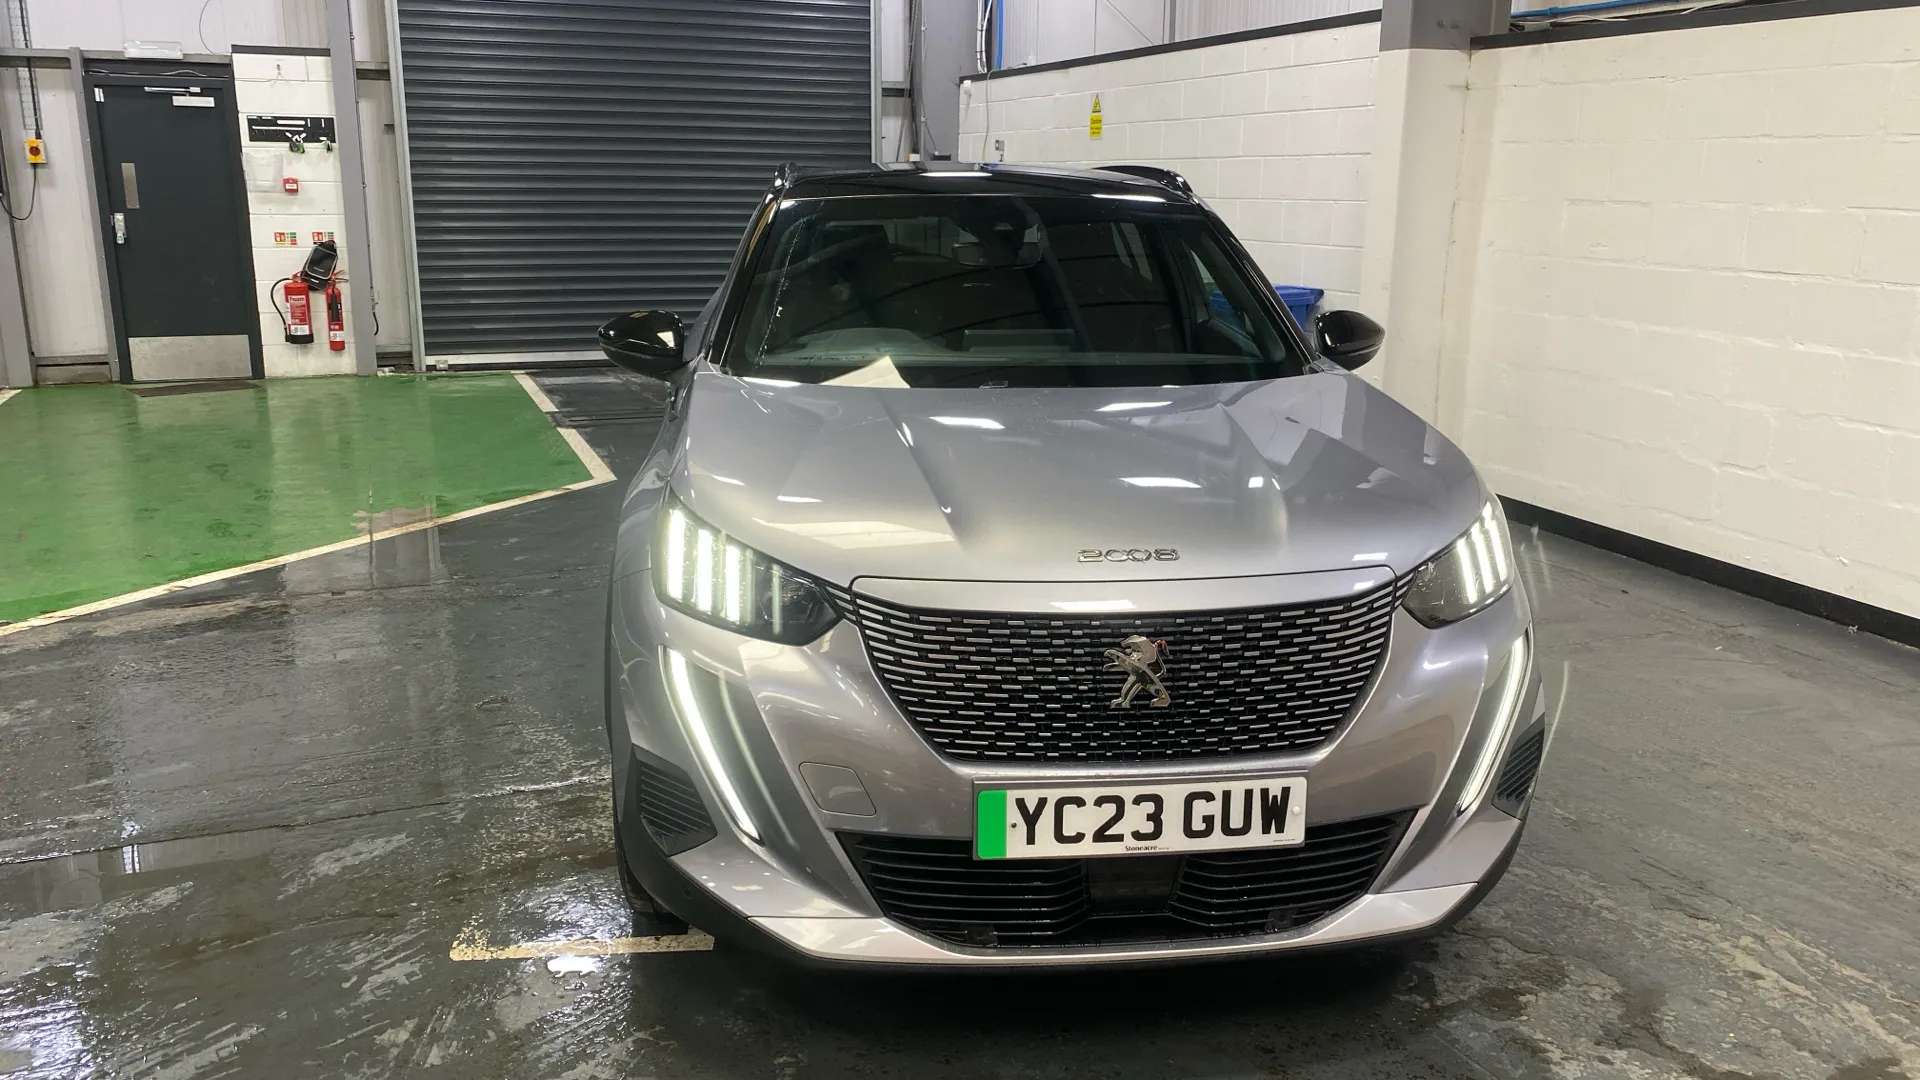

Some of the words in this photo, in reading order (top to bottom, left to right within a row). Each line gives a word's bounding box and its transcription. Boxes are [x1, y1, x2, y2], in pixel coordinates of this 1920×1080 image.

[1078, 548, 1180, 562] 2008
[1015, 793, 1164, 845] YC23
[1183, 786, 1291, 839] GUW
